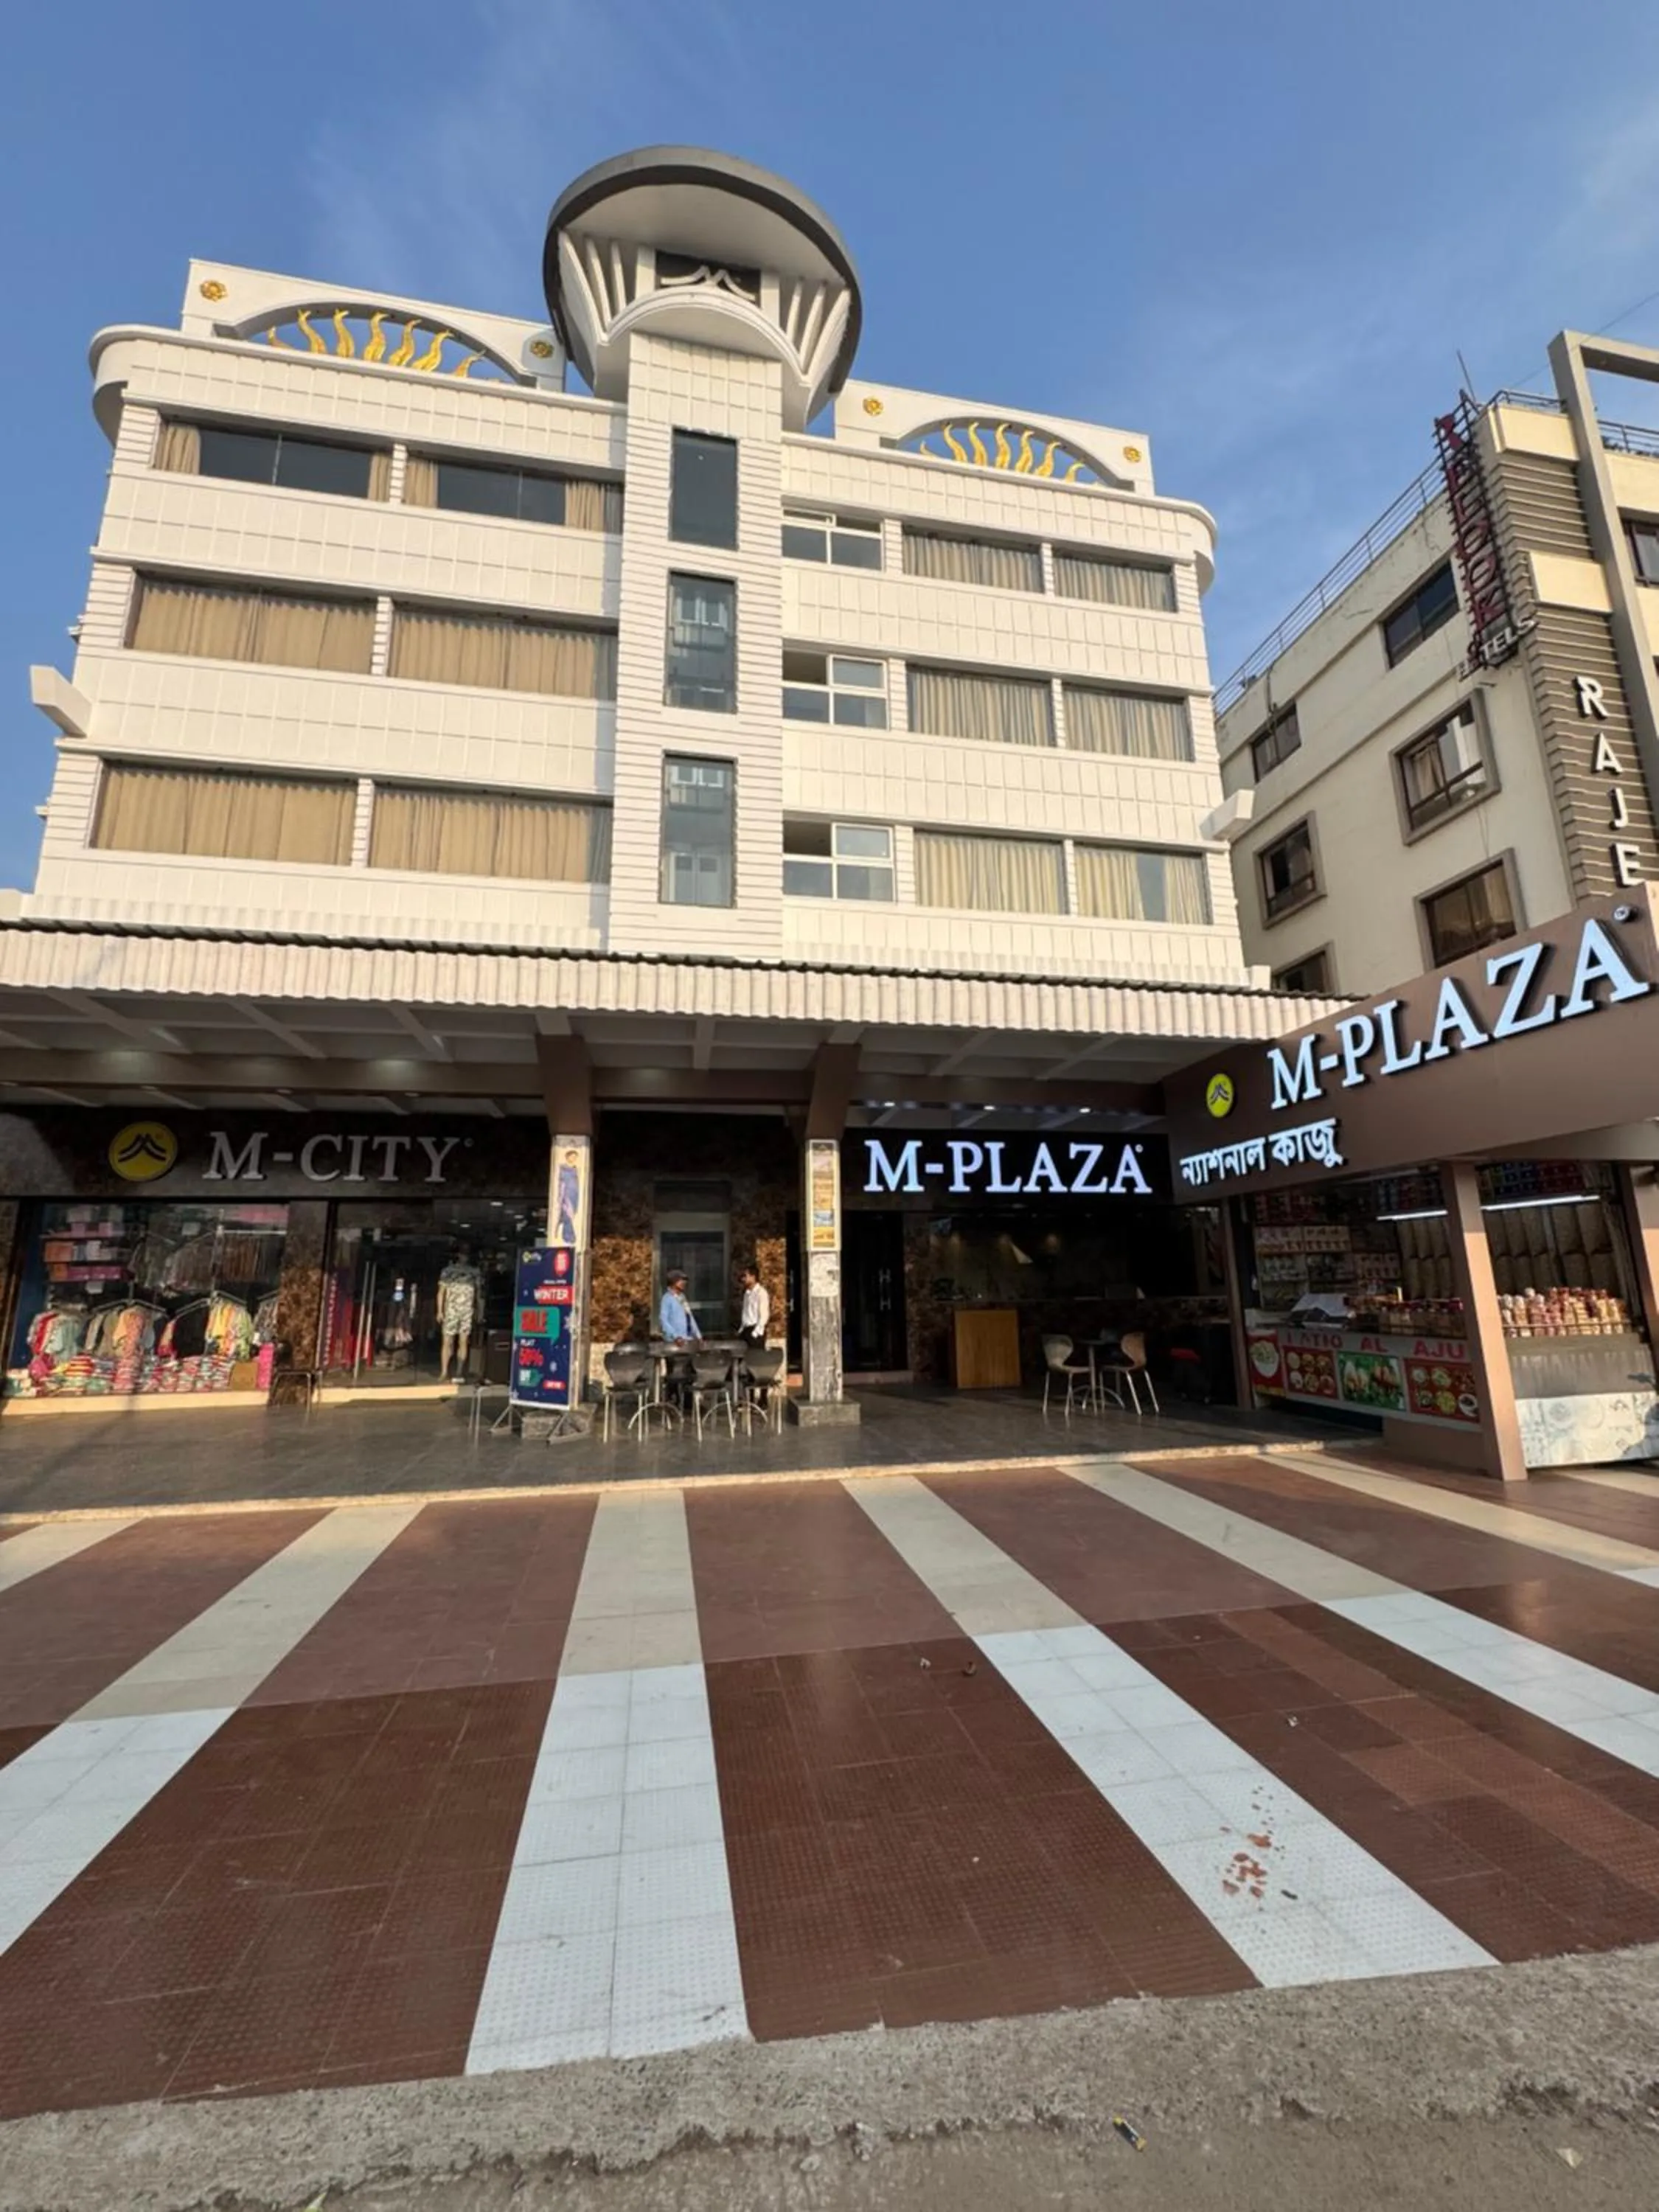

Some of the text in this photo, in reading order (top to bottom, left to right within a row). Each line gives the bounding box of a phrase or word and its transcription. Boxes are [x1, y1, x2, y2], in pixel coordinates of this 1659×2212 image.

[1576, 675, 1646, 886] RAJE
[1267, 918, 1649, 1110] M-PLAZA
[202, 1131, 460, 1182] M-CITY
[863, 1140, 1152, 1193] M-PLAZA
[1180, 1117, 1343, 1186] ন্যাশনাল কাজু
[520, 1309, 546, 1333] SALE
[533, 1288, 568, 1301] WINTER
